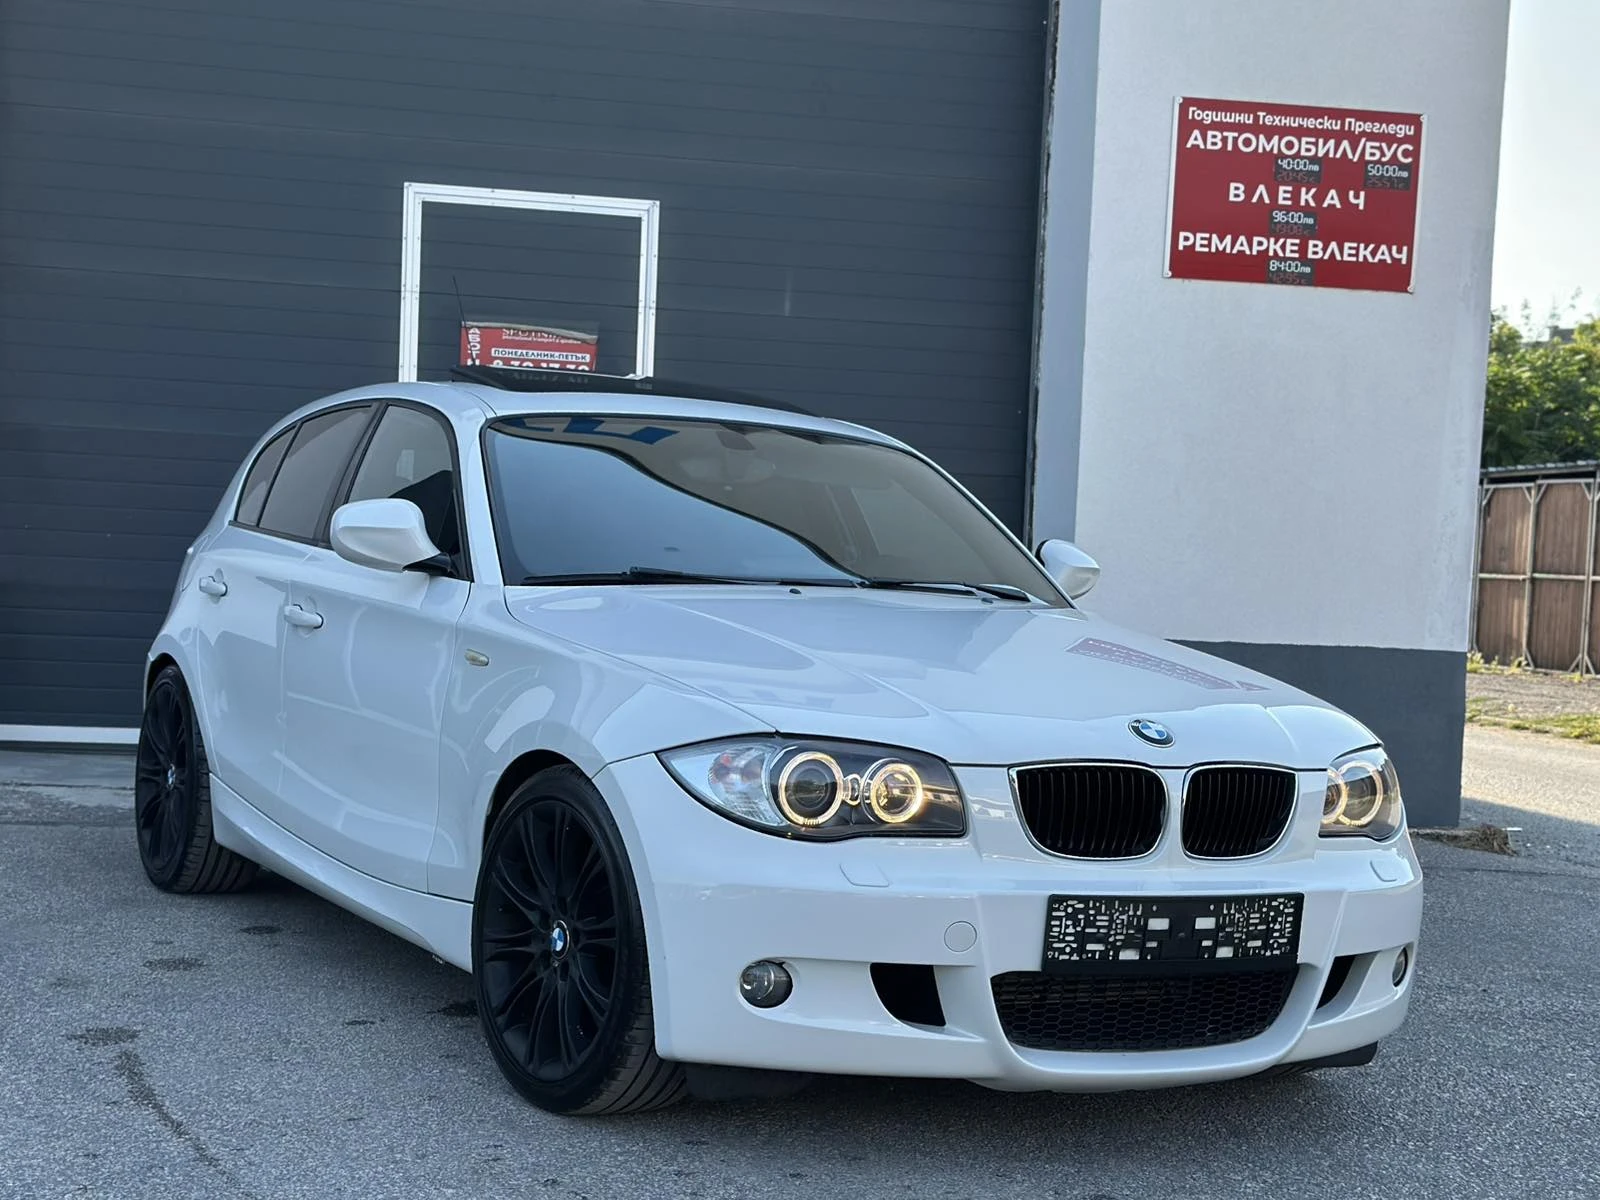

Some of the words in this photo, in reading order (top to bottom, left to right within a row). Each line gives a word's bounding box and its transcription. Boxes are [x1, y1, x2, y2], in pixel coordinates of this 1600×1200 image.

[1188, 107, 1253, 124] Годишни
[1257, 112, 1341, 130] Технически
[1344, 118, 1414, 138] Прегледи
[1186, 129, 1414, 163] АВТОМОБИЛ/БУС
[1178, 231, 1299, 258] РЕМАРКЕ
[1307, 240, 1408, 264] ВЛЕКАЧ
[493, 349, 588, 361] ПОНЕДЕЛНИК-ПЕТЪК
